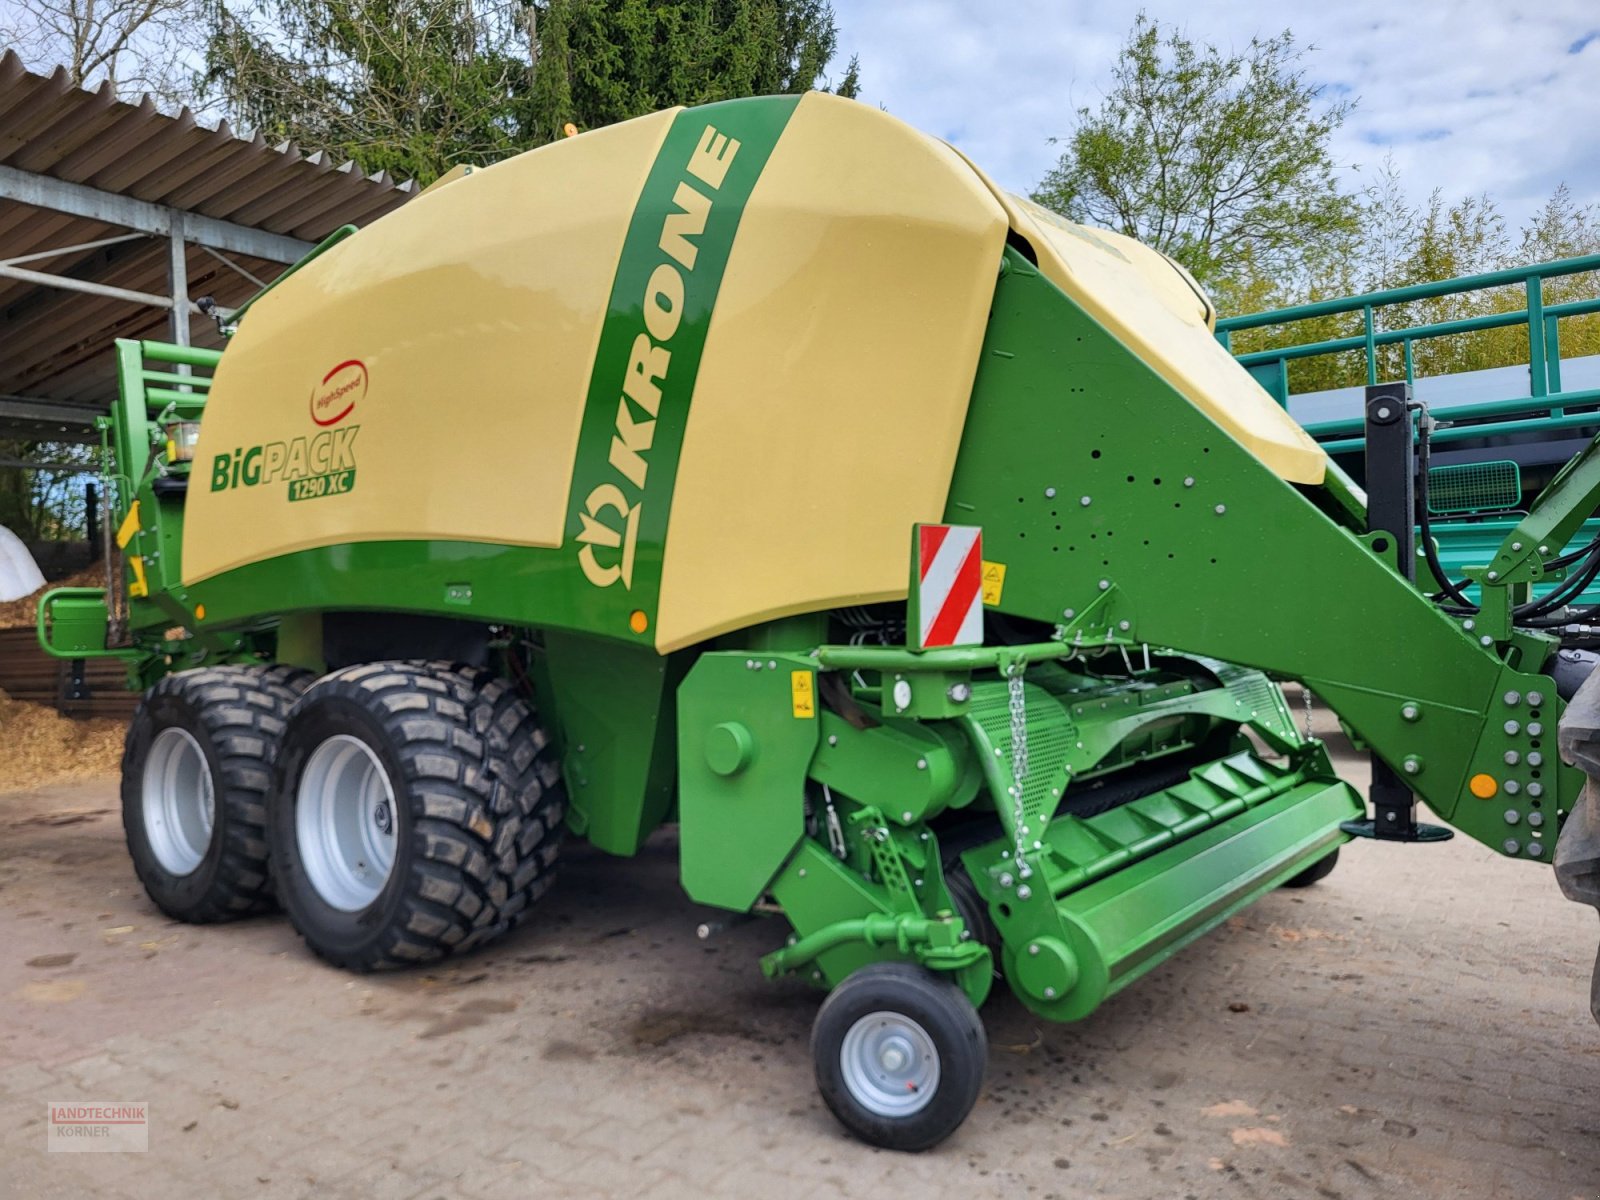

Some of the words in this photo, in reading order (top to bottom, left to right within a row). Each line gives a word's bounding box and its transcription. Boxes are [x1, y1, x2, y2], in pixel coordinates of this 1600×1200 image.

[608, 124, 742, 490] KRONE
[293, 477, 324, 500] 1290
[327, 472, 349, 494] XC
